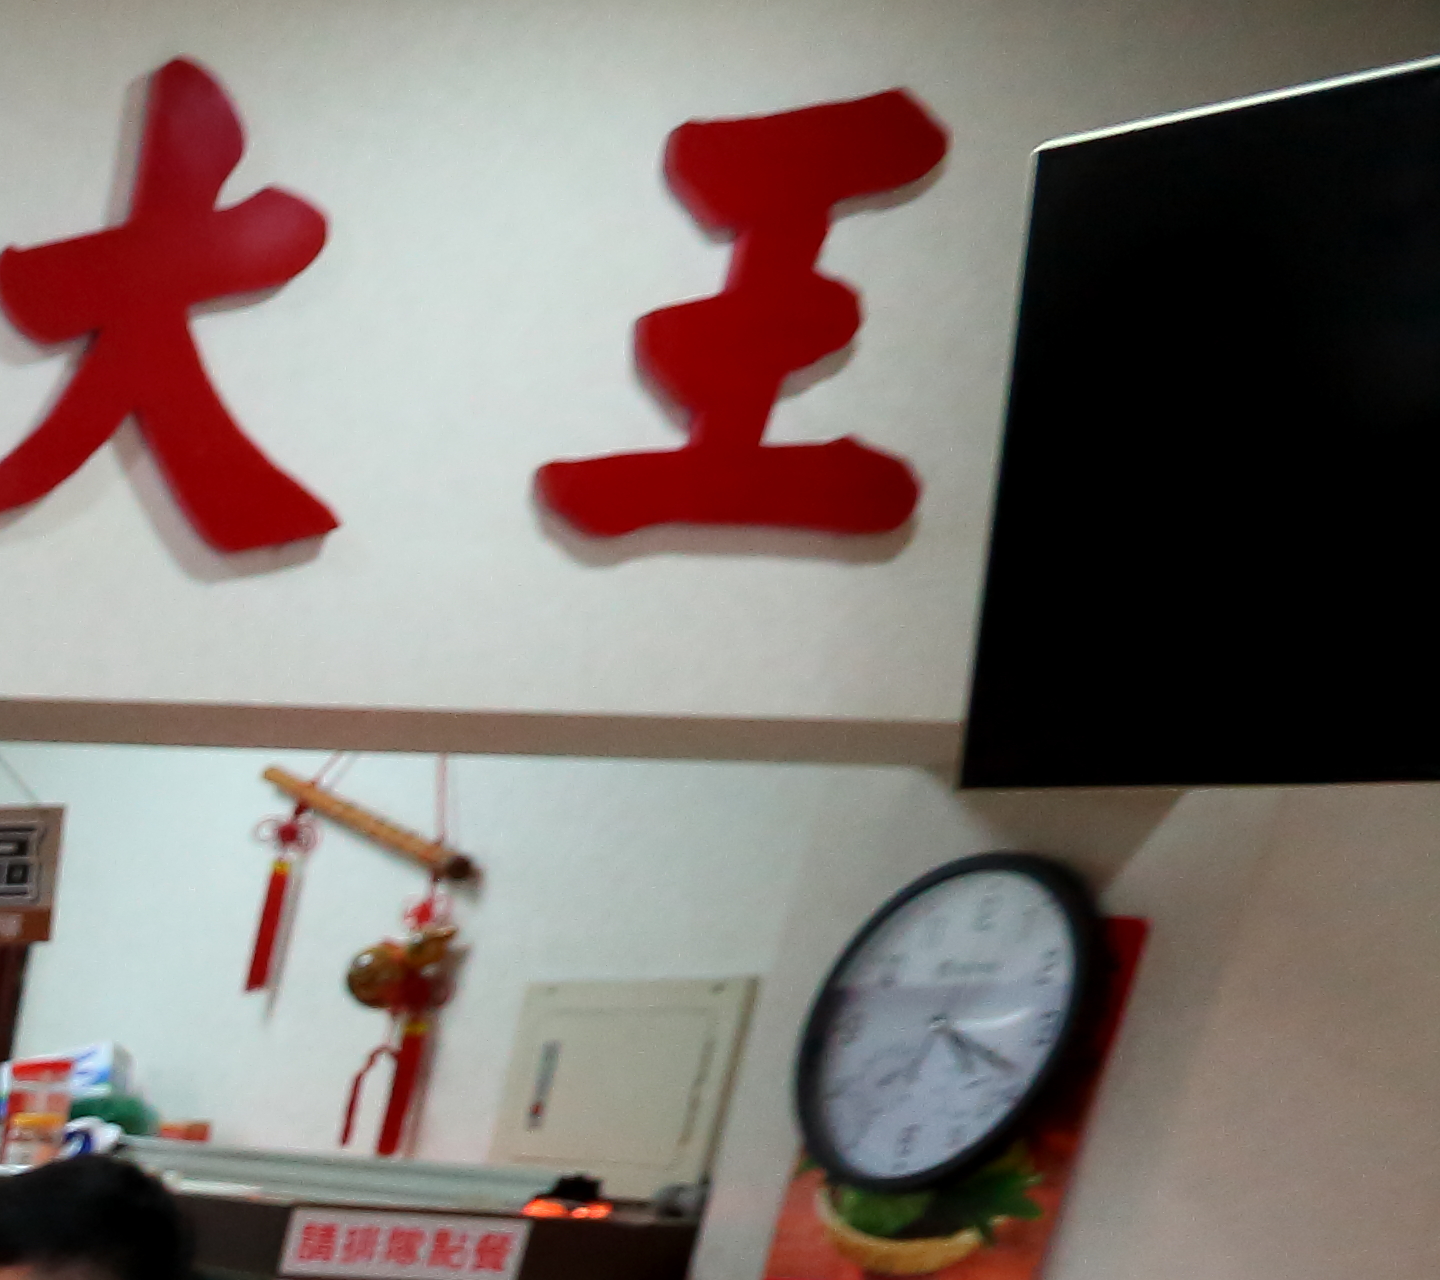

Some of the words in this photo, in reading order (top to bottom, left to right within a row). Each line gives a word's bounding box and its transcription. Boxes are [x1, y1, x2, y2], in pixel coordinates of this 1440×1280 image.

[297, 1221, 514, 1273] 請排隊點餐
